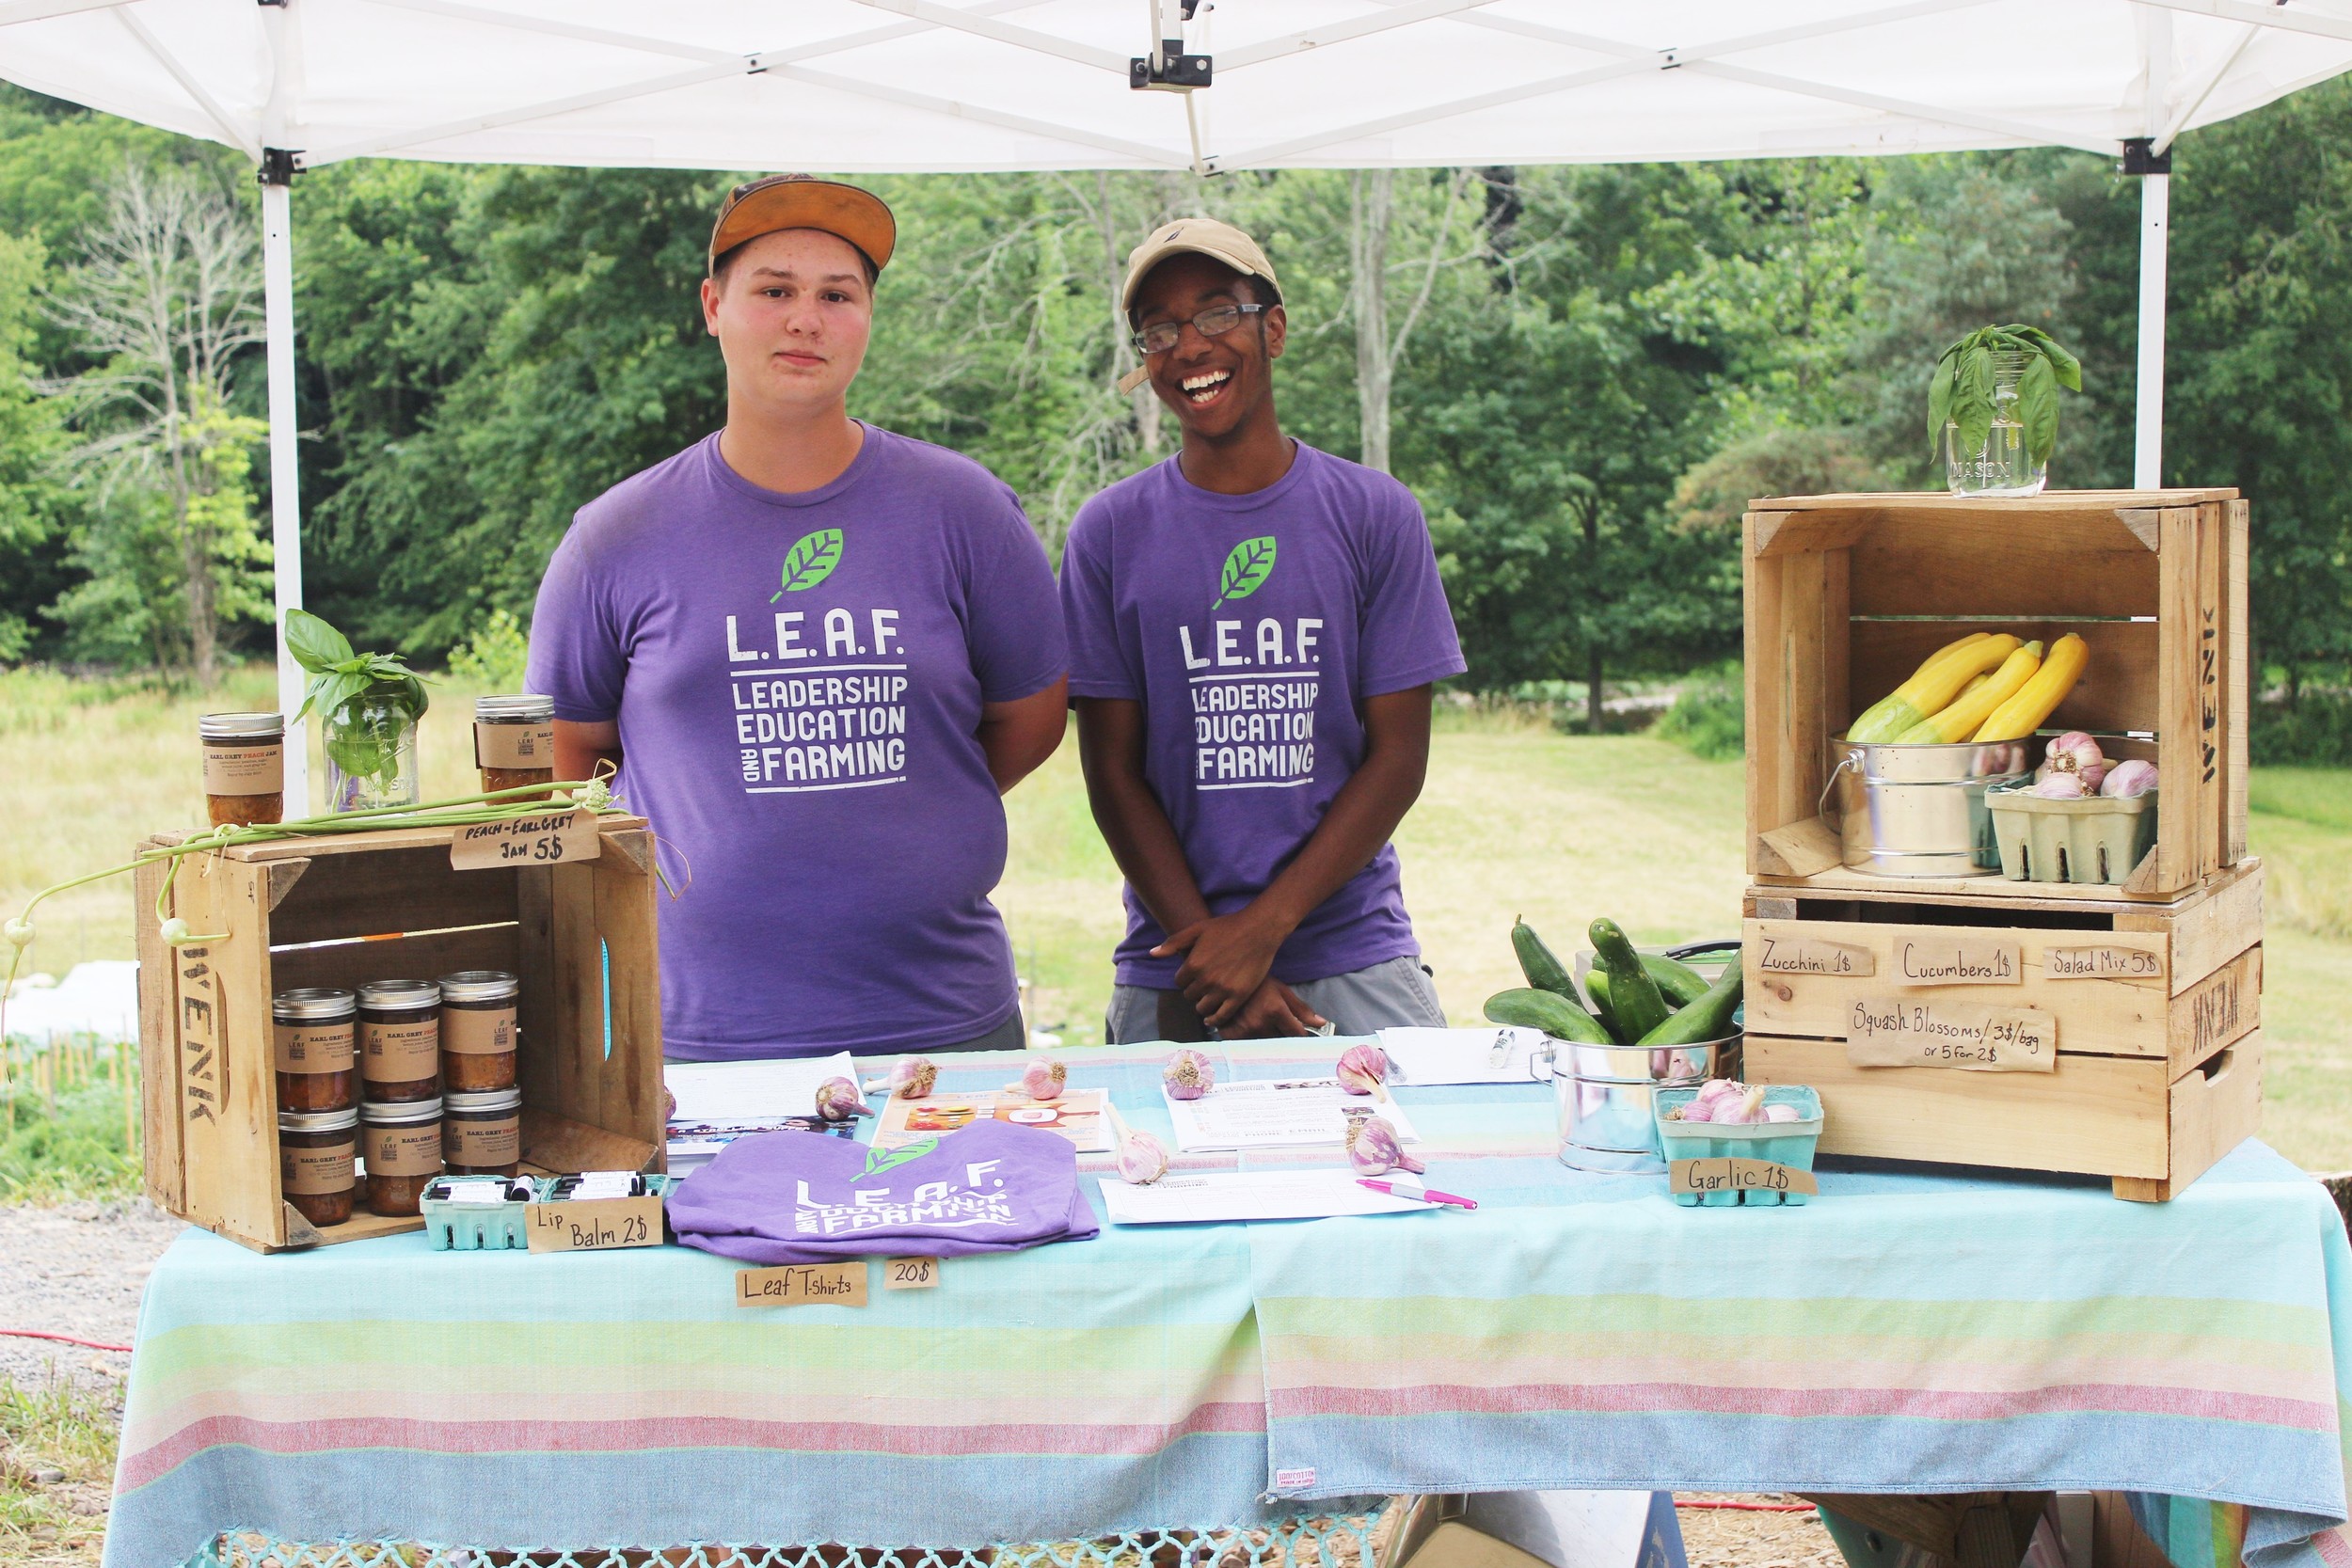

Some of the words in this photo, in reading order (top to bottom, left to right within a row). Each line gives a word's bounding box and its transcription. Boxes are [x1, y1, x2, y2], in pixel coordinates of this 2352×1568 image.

[726, 608, 905, 662] L.E.A.F.
[1179, 617, 1324, 670] L.E.A.F.
[732, 675, 908, 710] LEADERSHIP
[1191, 682, 1318, 713] LEADERSHIP
[2202, 607, 2216, 784] WENK
[736, 705, 906, 744] EDUCATION
[740, 749, 760, 782] AND
[761, 737, 906, 782] FARMING
[1199, 742, 1314, 780] FARMING
[533, 834, 563, 861] 5$
[1761, 939, 1826, 973] Zucchini
[1833, 950, 1851, 973] 1$
[1903, 942, 1993, 978] Cucumbers
[1994, 948, 2011, 976] 1$
[2054, 949, 2095, 974] Salad
[2100, 951, 2126, 971] Mix
[2131, 952, 2156, 974] 5$
[1853, 1002, 1909, 1037] Squash
[183, 946, 217, 1129] WENK
[1924, 1046, 1938, 1057] or
[1942, 1045, 1952, 1059] 5
[1977, 1046, 1997, 1063] 2$
[1689, 1160, 1756, 1189] Garlic
[1762, 1166, 1788, 1189] 1$
[537, 1205, 564, 1229] Lip
[570, 1218, 615, 1247] Balm
[623, 1214, 647, 1243] 2$
[744, 1267, 795, 1298] Leaf
[895, 1260, 930, 1282] 20$
